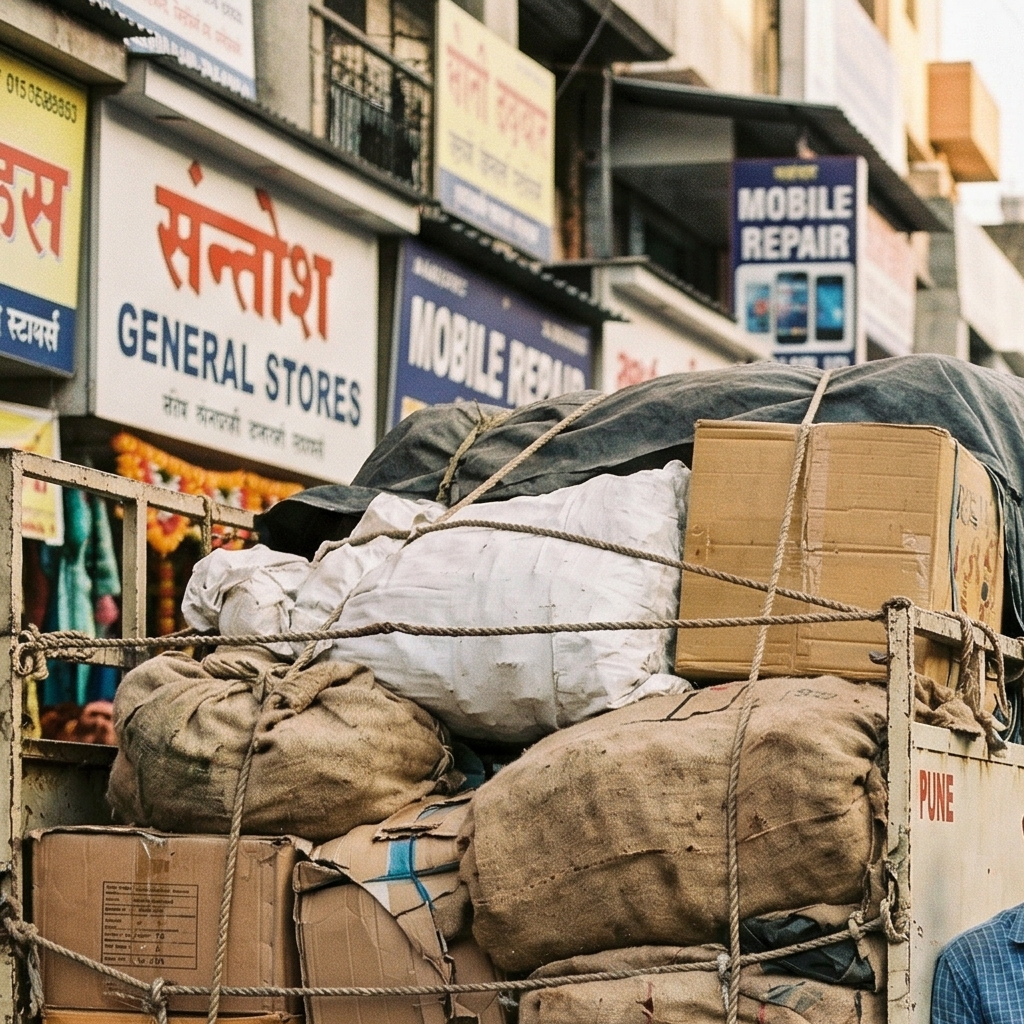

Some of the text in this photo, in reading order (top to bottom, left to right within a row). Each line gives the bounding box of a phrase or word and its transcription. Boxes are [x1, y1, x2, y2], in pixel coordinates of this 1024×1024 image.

[737, 185, 854, 221] MOBILE
[740, 224, 851, 262] REPAIR
[117, 301, 255, 395] GENERAL
[265, 353, 361, 428] STORES
[408, 294, 507, 400] MOBILE
[919, 769, 954, 823] PUNE
